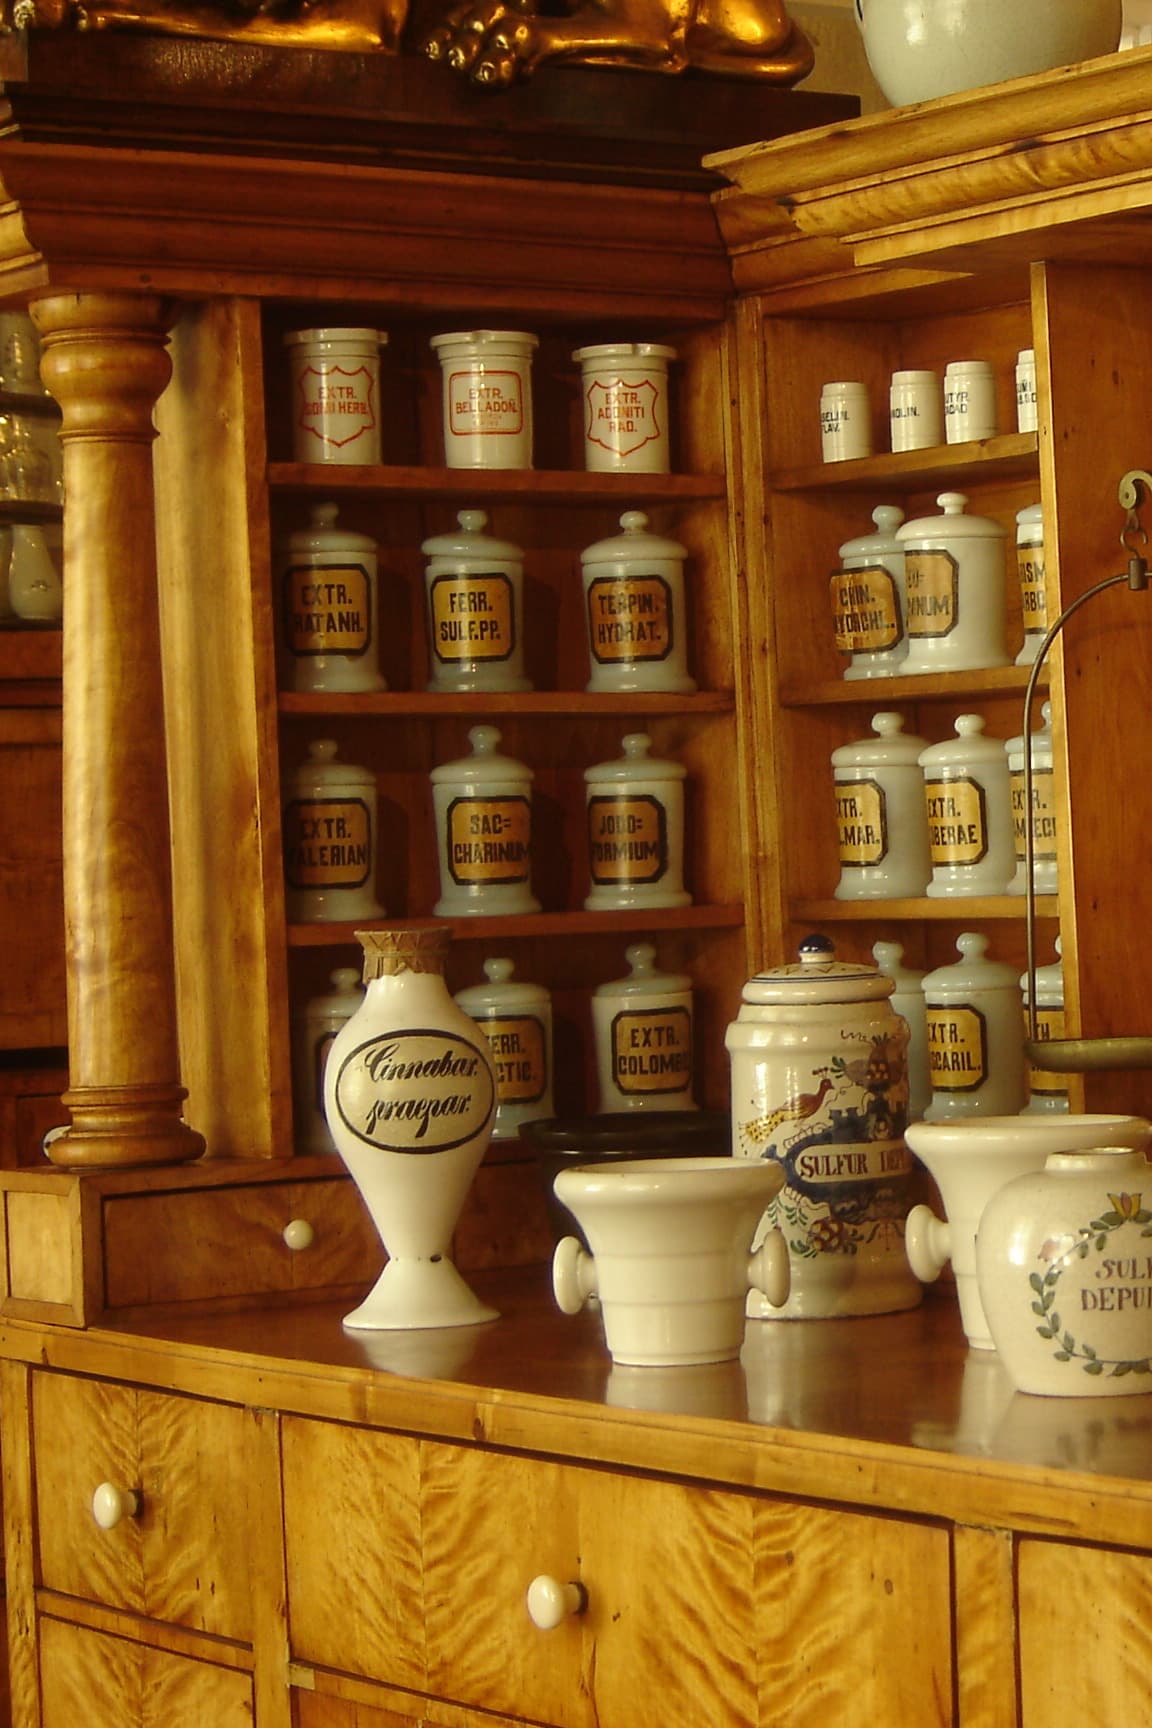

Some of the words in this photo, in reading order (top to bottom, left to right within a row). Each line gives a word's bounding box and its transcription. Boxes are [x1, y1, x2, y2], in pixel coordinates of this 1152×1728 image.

[302, 583, 353, 605] EXTR.
[449, 591, 493, 613] FERR.
[836, 797, 863, 819] XTR.
[1012, 788, 1047, 810] EXR.
[288, 845, 367, 867] ALERIAN
[630, 1026, 680, 1048] EXTR.
[364, 1042, 478, 1083] Cinnabar.
[800, 1153, 869, 1178] SULFUR
